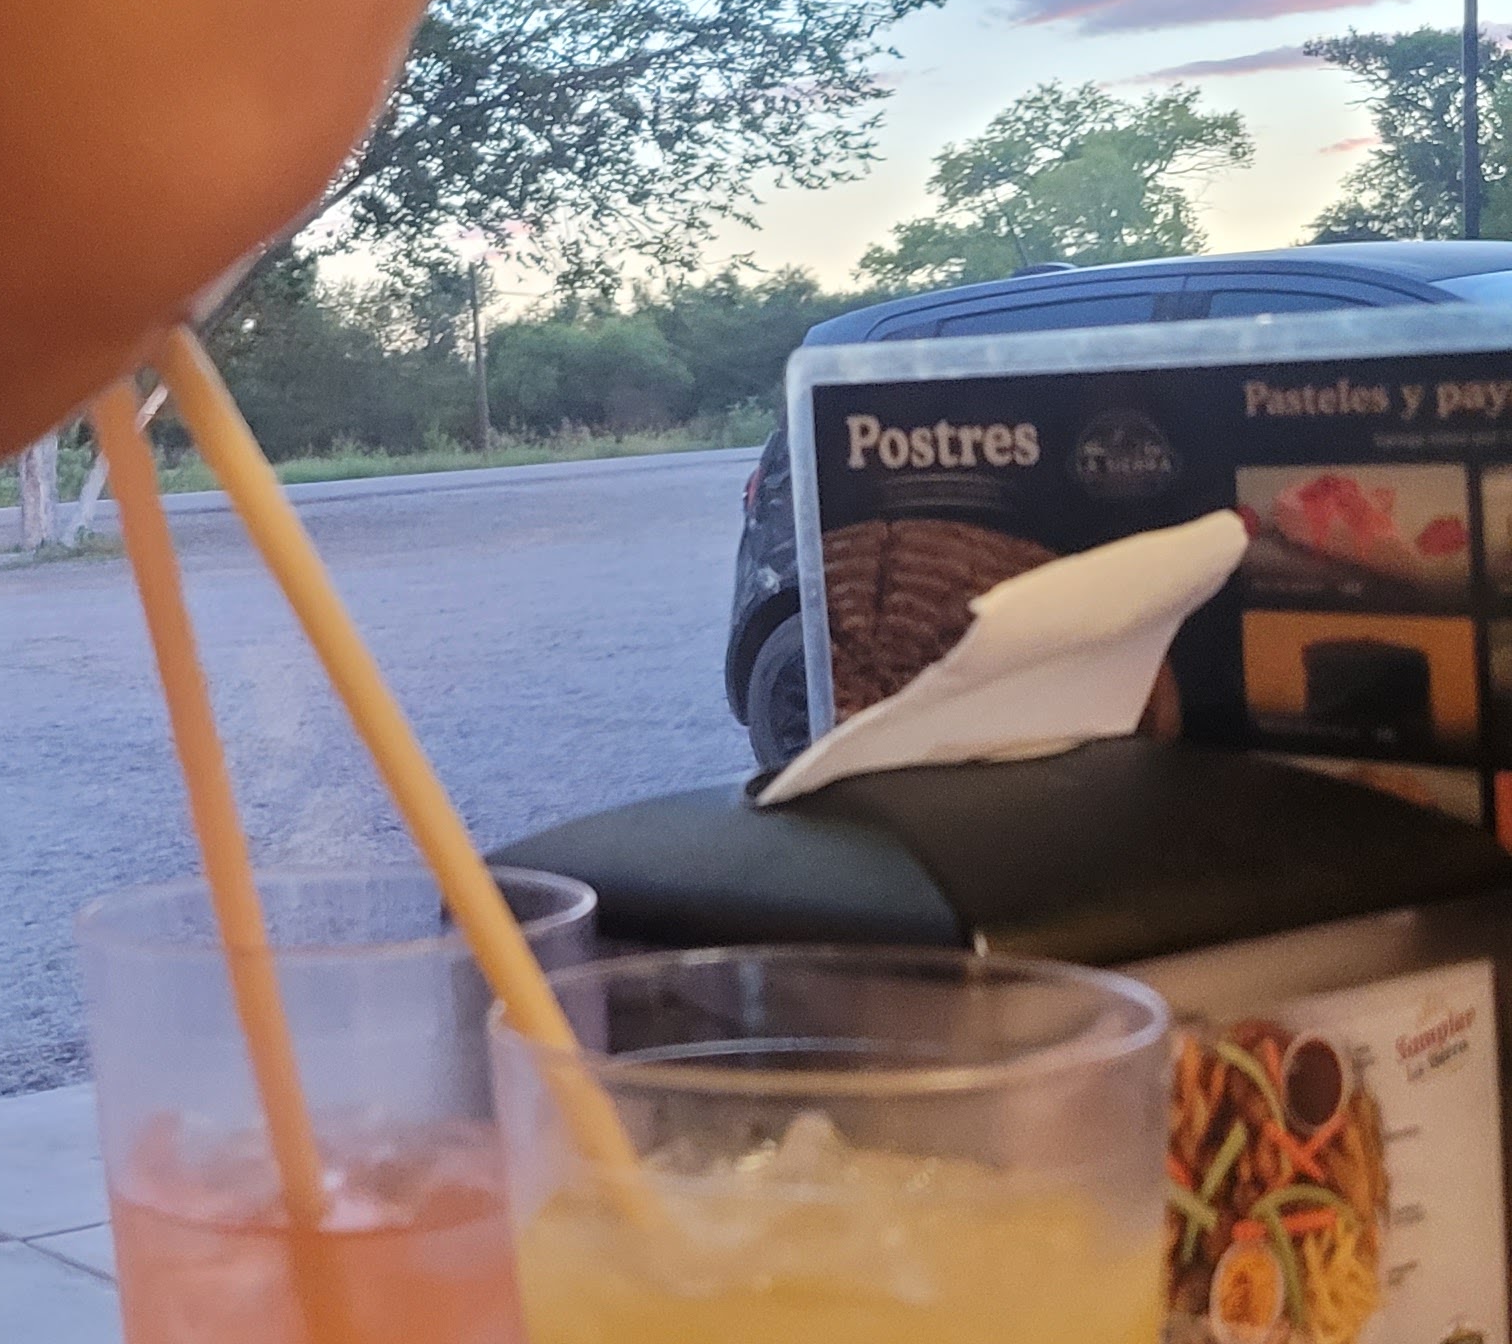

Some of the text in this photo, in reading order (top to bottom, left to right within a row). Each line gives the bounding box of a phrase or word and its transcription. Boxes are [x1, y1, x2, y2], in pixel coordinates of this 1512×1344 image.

[1245, 378, 1389, 418] Pasteles
[1401, 385, 1423, 420] y
[845, 413, 1040, 469] Postres
